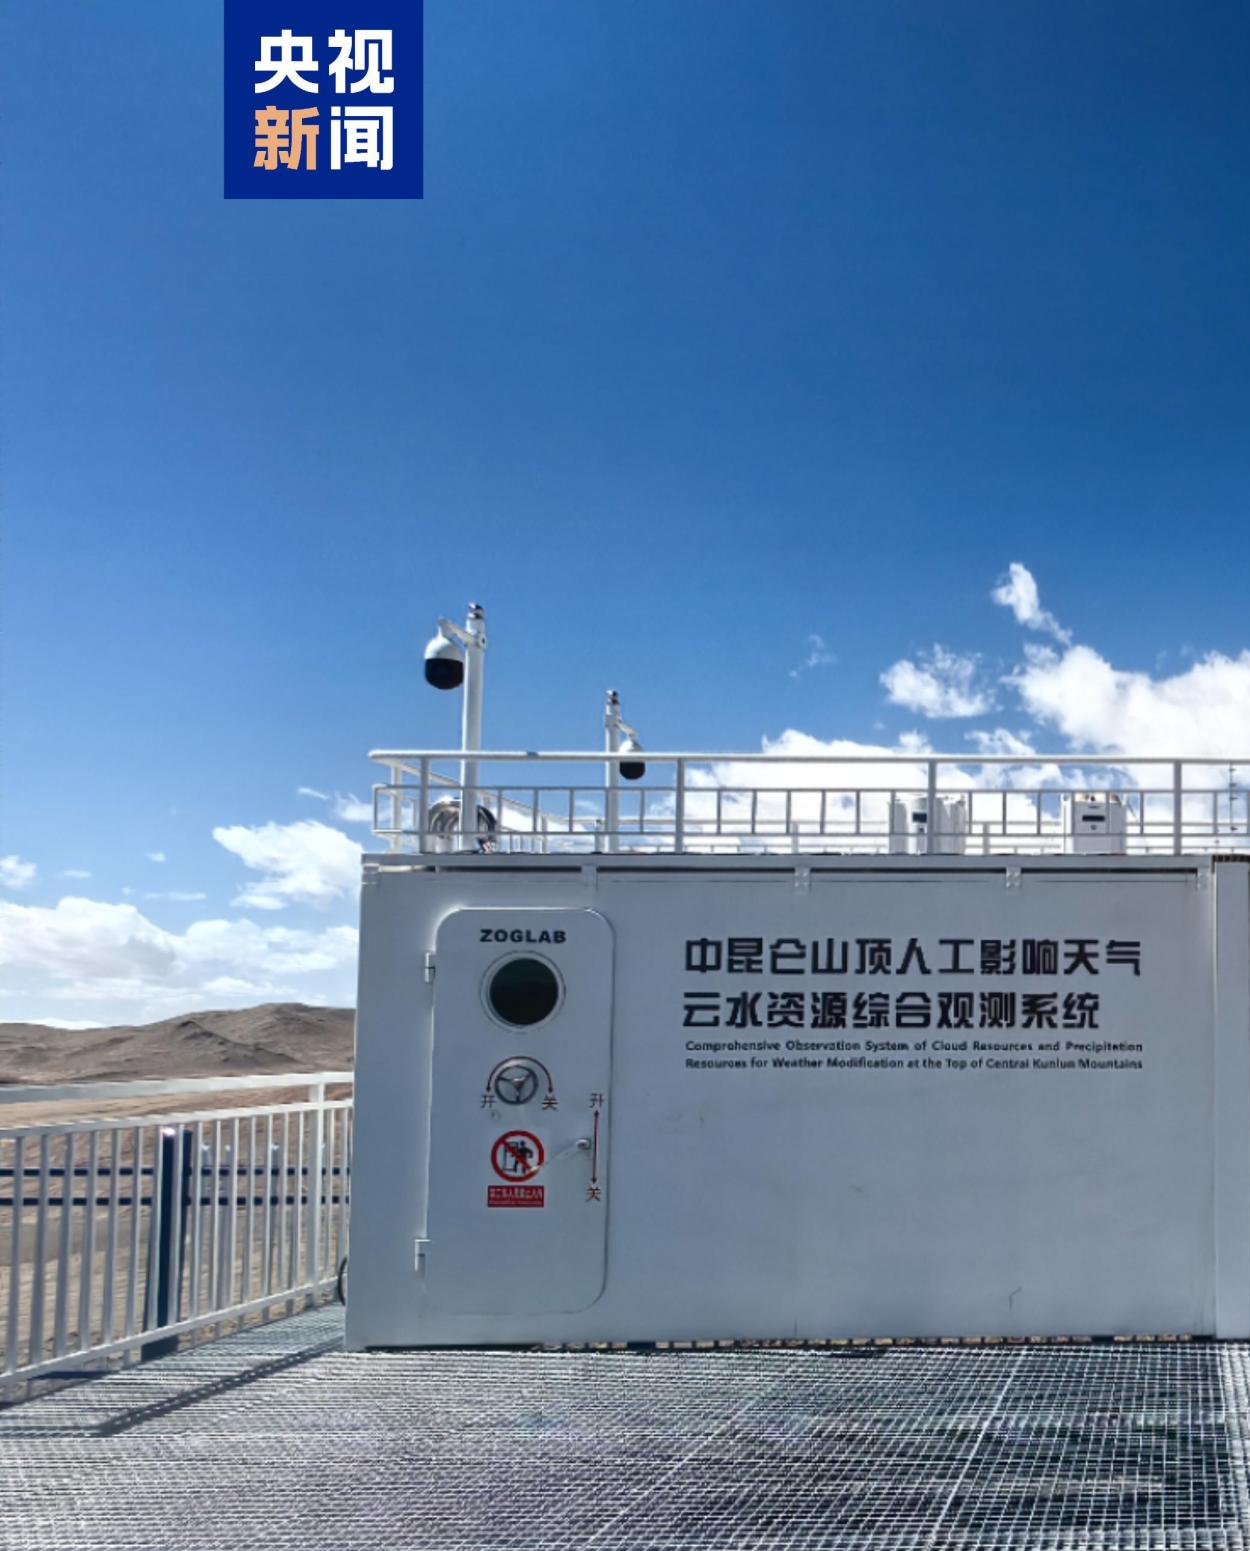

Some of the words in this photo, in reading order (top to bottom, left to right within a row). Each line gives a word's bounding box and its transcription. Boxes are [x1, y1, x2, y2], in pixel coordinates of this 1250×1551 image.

[480, 929, 567, 944] ZOGLAB
[685, 937, 1141, 976] 中昆仑山顶人工影响天气
[683, 991, 1100, 1029] 云水资源综合观测系统
[685, 1040, 781, 1053] Comprehensive
[785, 1040, 861, 1051] Observation
[865, 1040, 909, 1053] System
[914, 1040, 927, 1051] of
[931, 1040, 968, 1051] Cloud
[973, 1040, 1033, 1051] Resources
[1038, 1041, 1060, 1051] and
[1066, 1041, 1142, 1053] Precipitation
[685, 1058, 747, 1069] Resources
[750, 1056, 768, 1069] for
[772, 1057, 823, 1069] Weather
[826, 1056, 904, 1069] Modification
[907, 1058, 919, 1069] at
[922, 1057, 942, 1069] the
[945, 1058, 967, 1071] Top
[970, 1057, 983, 1069] of
[986, 1057, 1029, 1069] Central
[1033, 1057, 1076, 1069] Kunlun
[1078, 1057, 1143, 1069] Mountains
[481, 1095, 496, 1109] 开
[541, 1095, 558, 1110] 关
